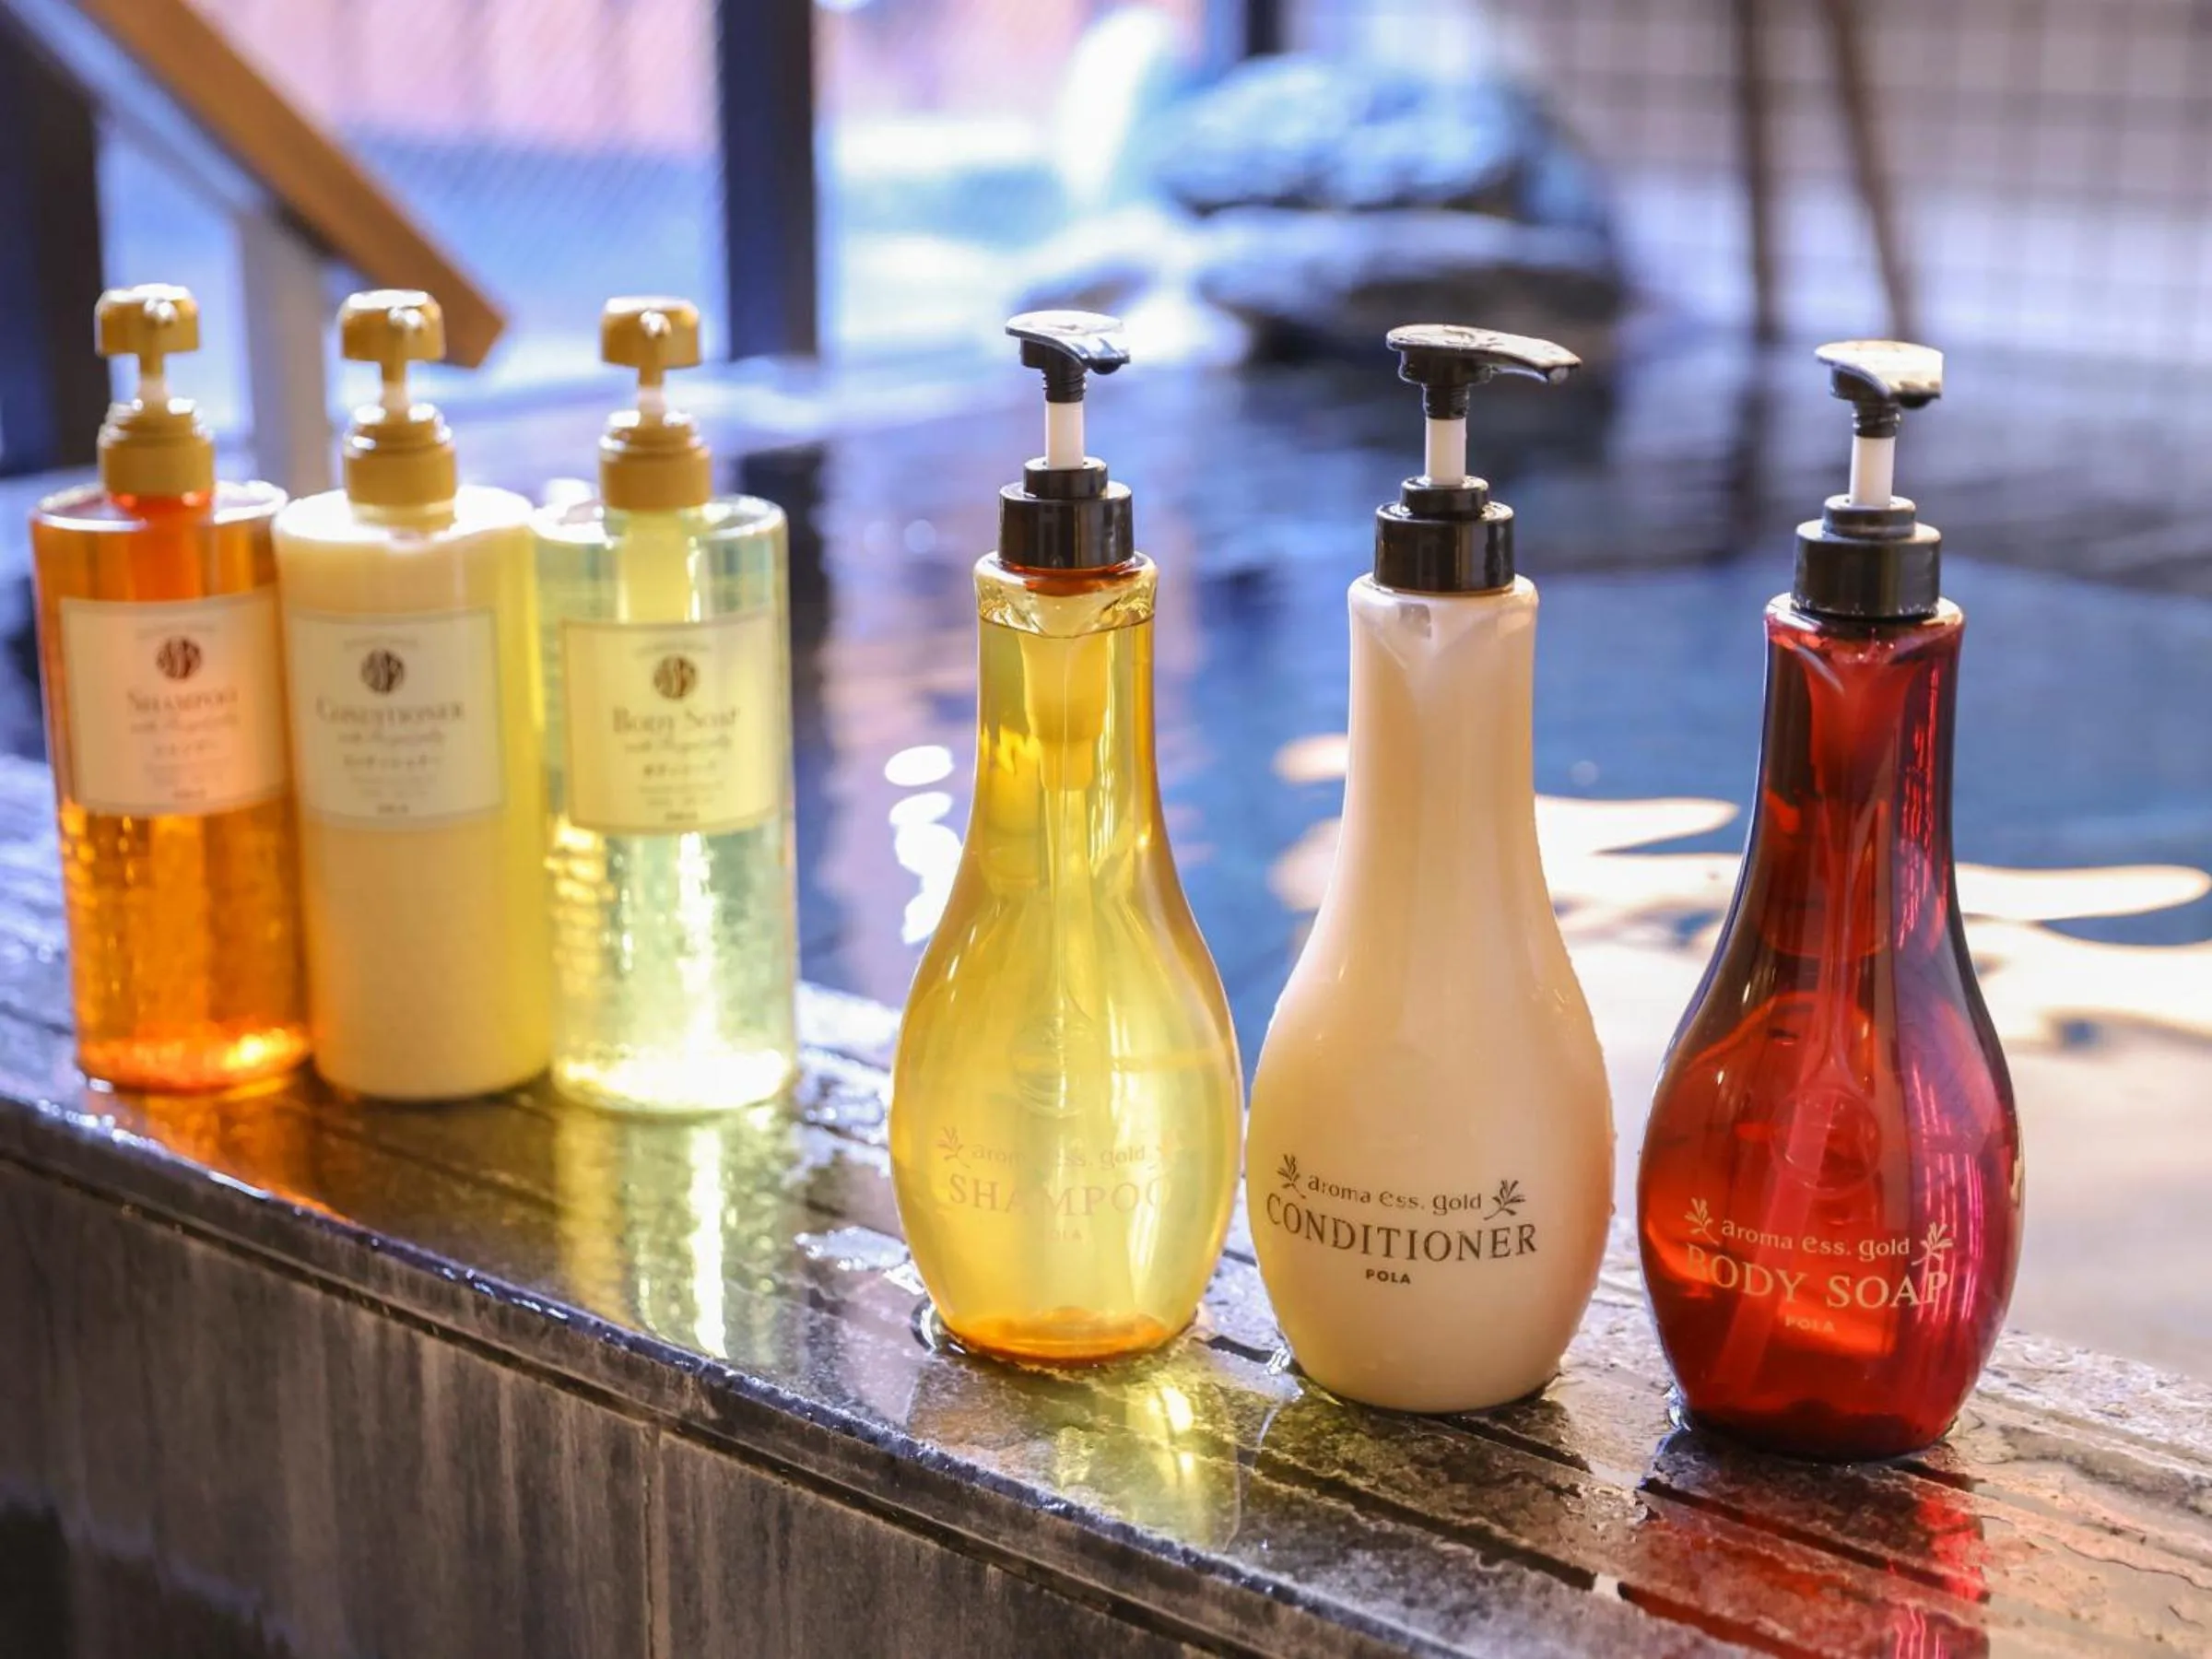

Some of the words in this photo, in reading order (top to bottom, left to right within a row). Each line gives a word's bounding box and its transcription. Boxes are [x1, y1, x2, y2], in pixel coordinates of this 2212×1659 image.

[1099, 1146, 1146, 1171] gold
[1307, 1173, 1371, 1205] aroma
[1378, 1190, 1426, 1211] ess.
[1431, 1193, 1483, 1217] gold
[1266, 1192, 1538, 1263] CONDITIONER
[1721, 1218, 1794, 1252] aroma
[1800, 1234, 1853, 1257] ess.
[1857, 1237, 1911, 1263] gold
[1365, 1268, 1412, 1286] POLA
[1685, 1241, 1808, 1304] BODY
[1825, 1271, 1949, 1309] SOAP
[1784, 1315, 1836, 1334] POLA
